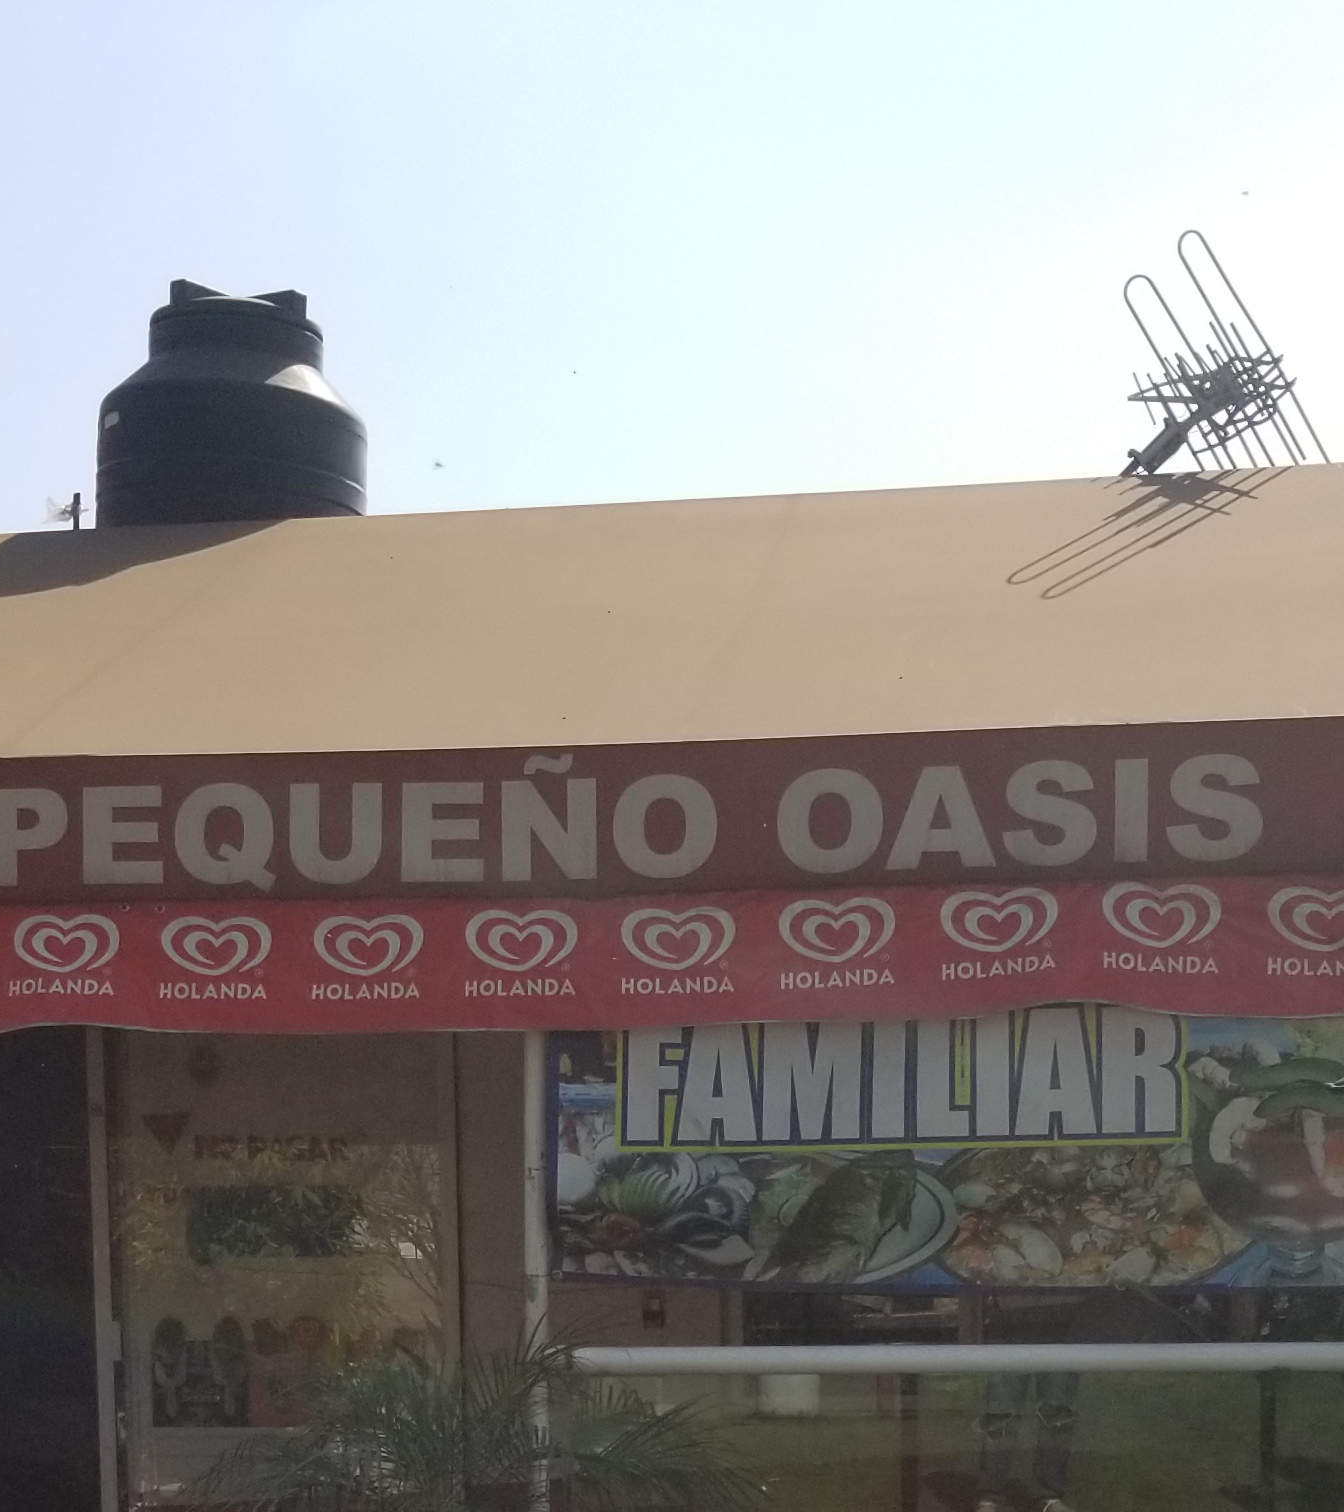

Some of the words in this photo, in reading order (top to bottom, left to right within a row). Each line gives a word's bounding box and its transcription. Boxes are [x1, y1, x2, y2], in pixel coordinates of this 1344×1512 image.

[775, 752, 1266, 876] OASIS
[941, 954, 1057, 982] HOLANDA
[1102, 950, 1220, 976] HOLANDA
[8, 978, 115, 997] HOLANDA
[464, 978, 577, 998] HOLANDA
[620, 975, 736, 995] HOLANDA
[779, 969, 896, 991] HOLANDA
[159, 981, 269, 1001] HOLANDA
[311, 981, 421, 1001] HOLANDA
[625, 1006, 1178, 1140] FAMILIAR
